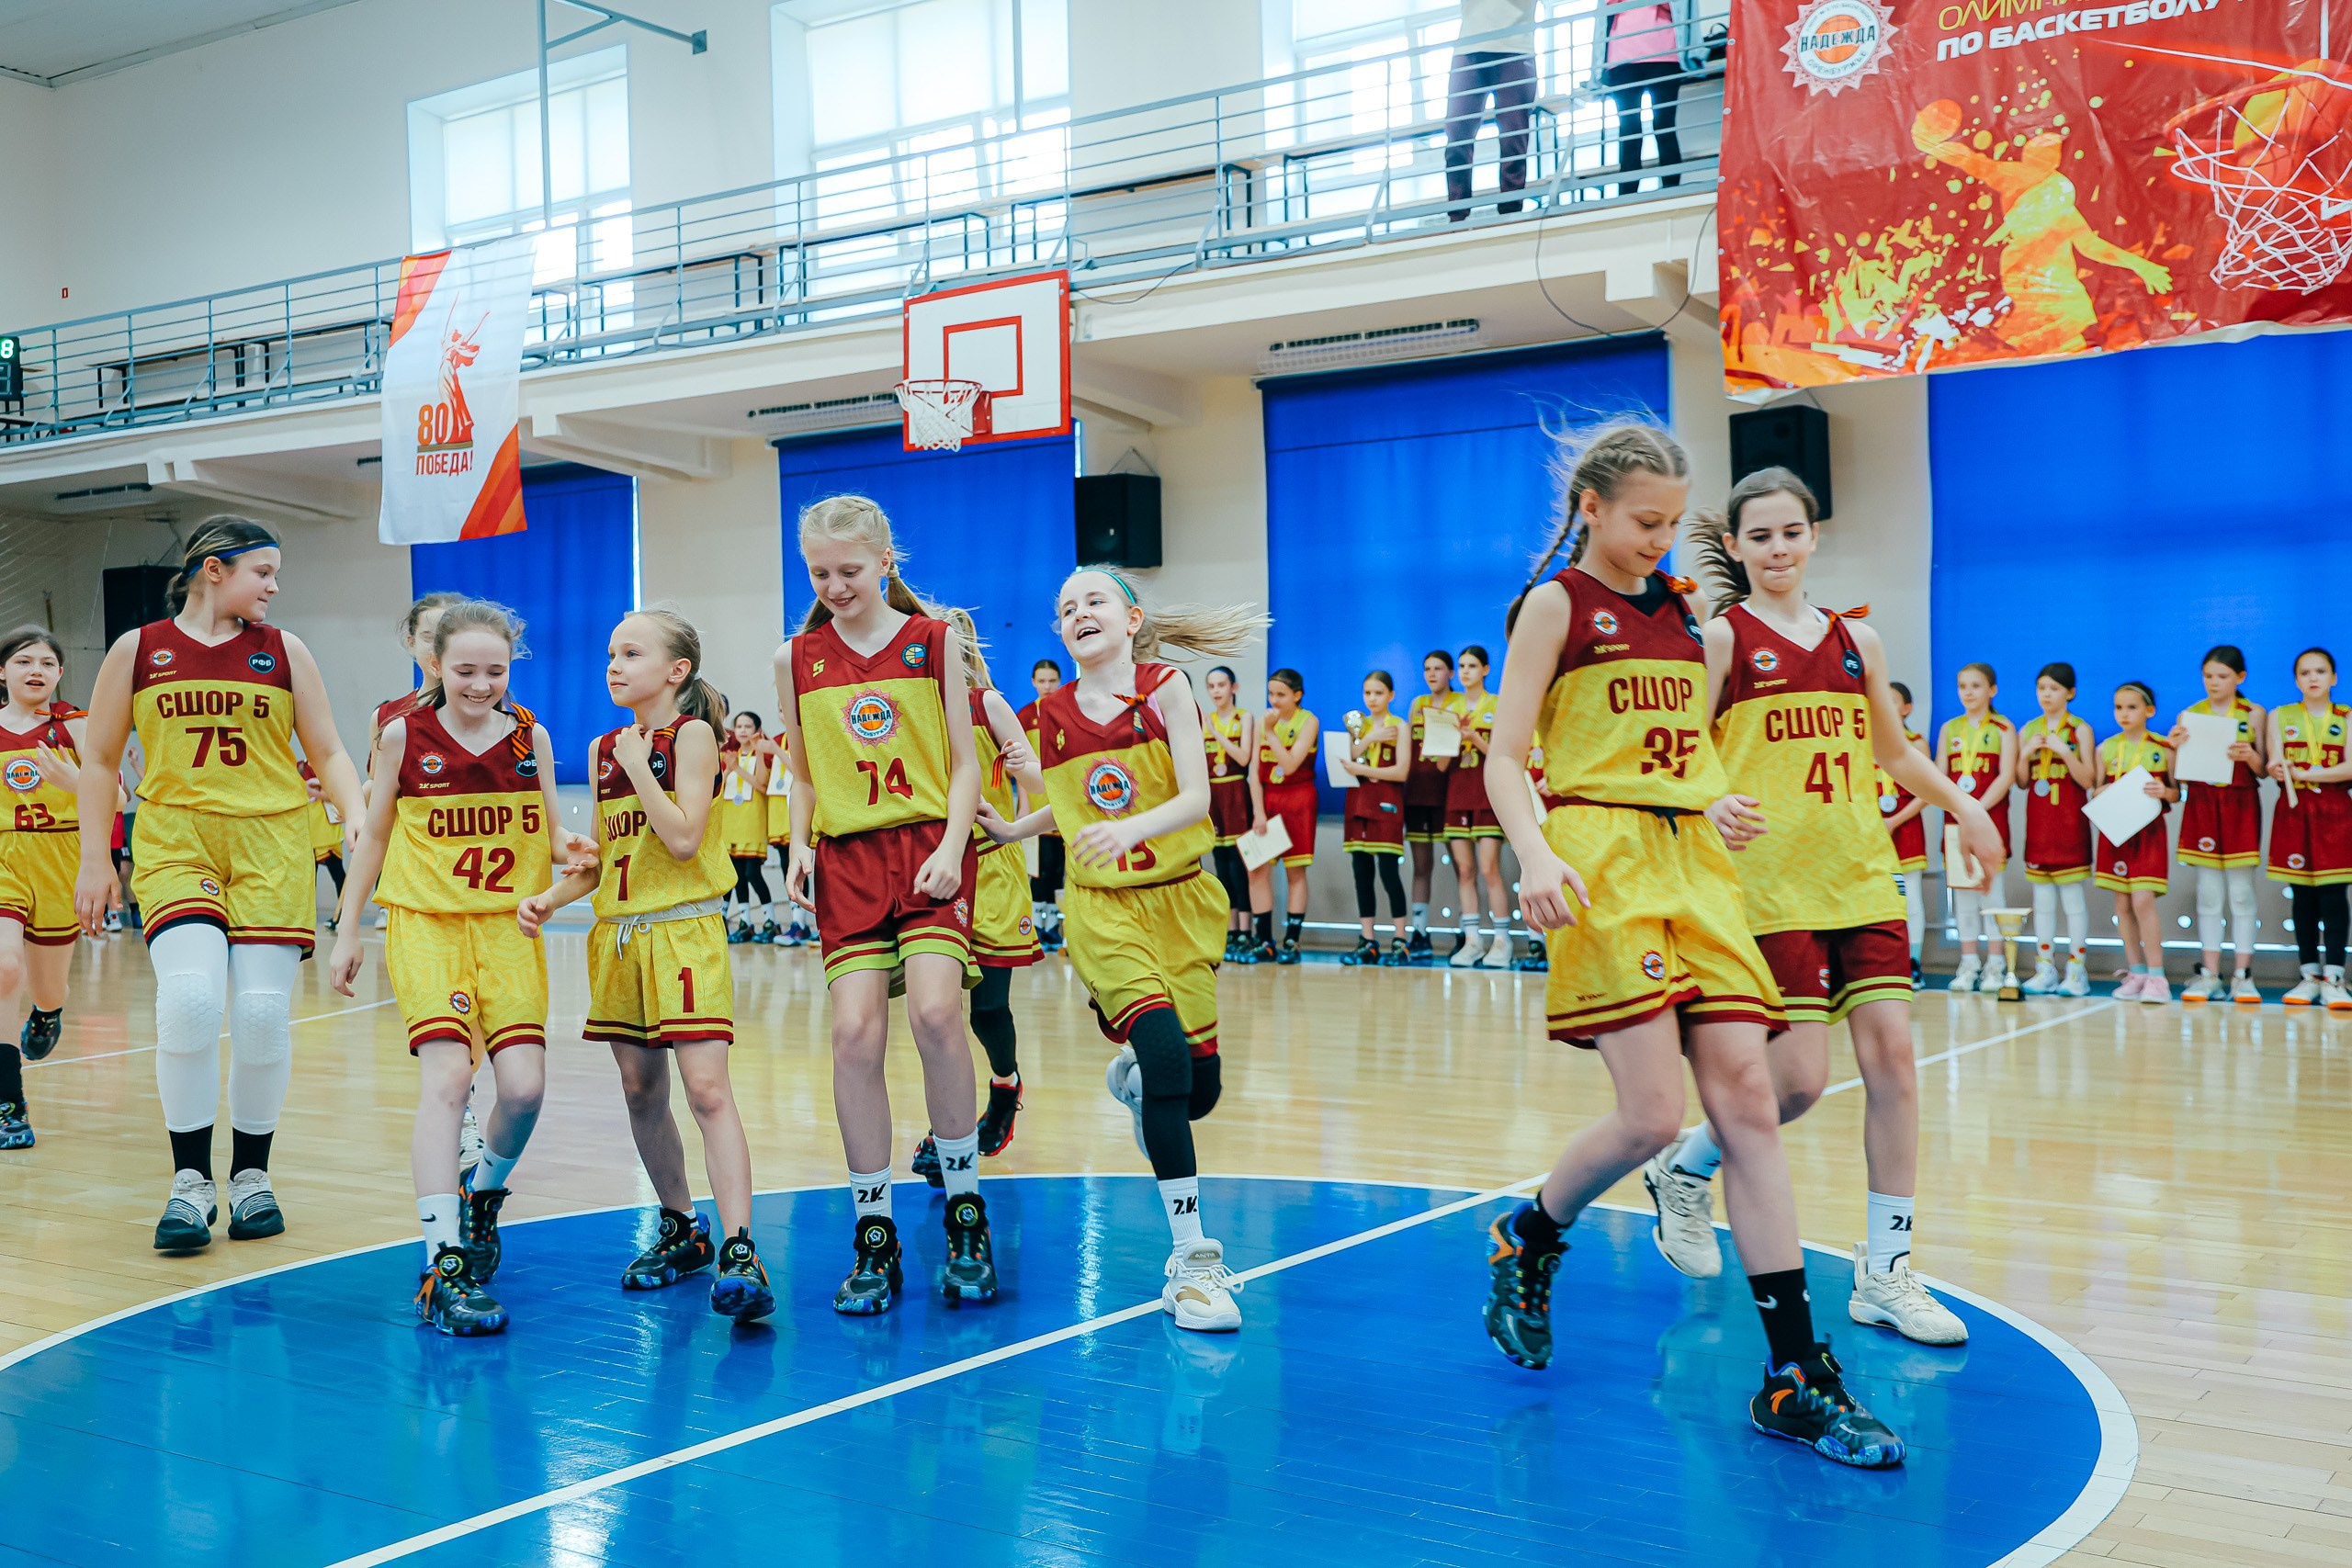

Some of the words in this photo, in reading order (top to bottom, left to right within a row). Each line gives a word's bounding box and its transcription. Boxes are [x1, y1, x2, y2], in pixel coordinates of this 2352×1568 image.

[1801, 25, 1876, 53] НАДЕЖДА
[1936, 30, 1984, 62] ПО
[418, 402, 448, 445] 80
[416, 450, 473, 477] ПОБЕДА!
[252, 659, 272, 667] РФБ
[156, 690, 244, 719] СШОР
[253, 694, 270, 718] 5
[1609, 676, 1692, 715] СШОР
[851, 709, 892, 725] НАДЕЖДА
[1766, 705, 1844, 742] СШОР
[1852, 708, 1865, 740] 5
[186, 727, 247, 768] 75
[1640, 727, 1700, 778] 35
[855, 757, 914, 807] 74
[1805, 751, 1851, 804] 41
[15, 803, 56, 830] 63
[427, 807, 514, 838] СШОР
[522, 804, 540, 834] 5
[452, 847, 515, 894] 42
[614, 854, 631, 901] 1
[677, 966, 695, 1013] 1
[944, 1152, 975, 1171] 2K
[857, 1182, 888, 1203] 2K
[1172, 1195, 1198, 1215] 2K
